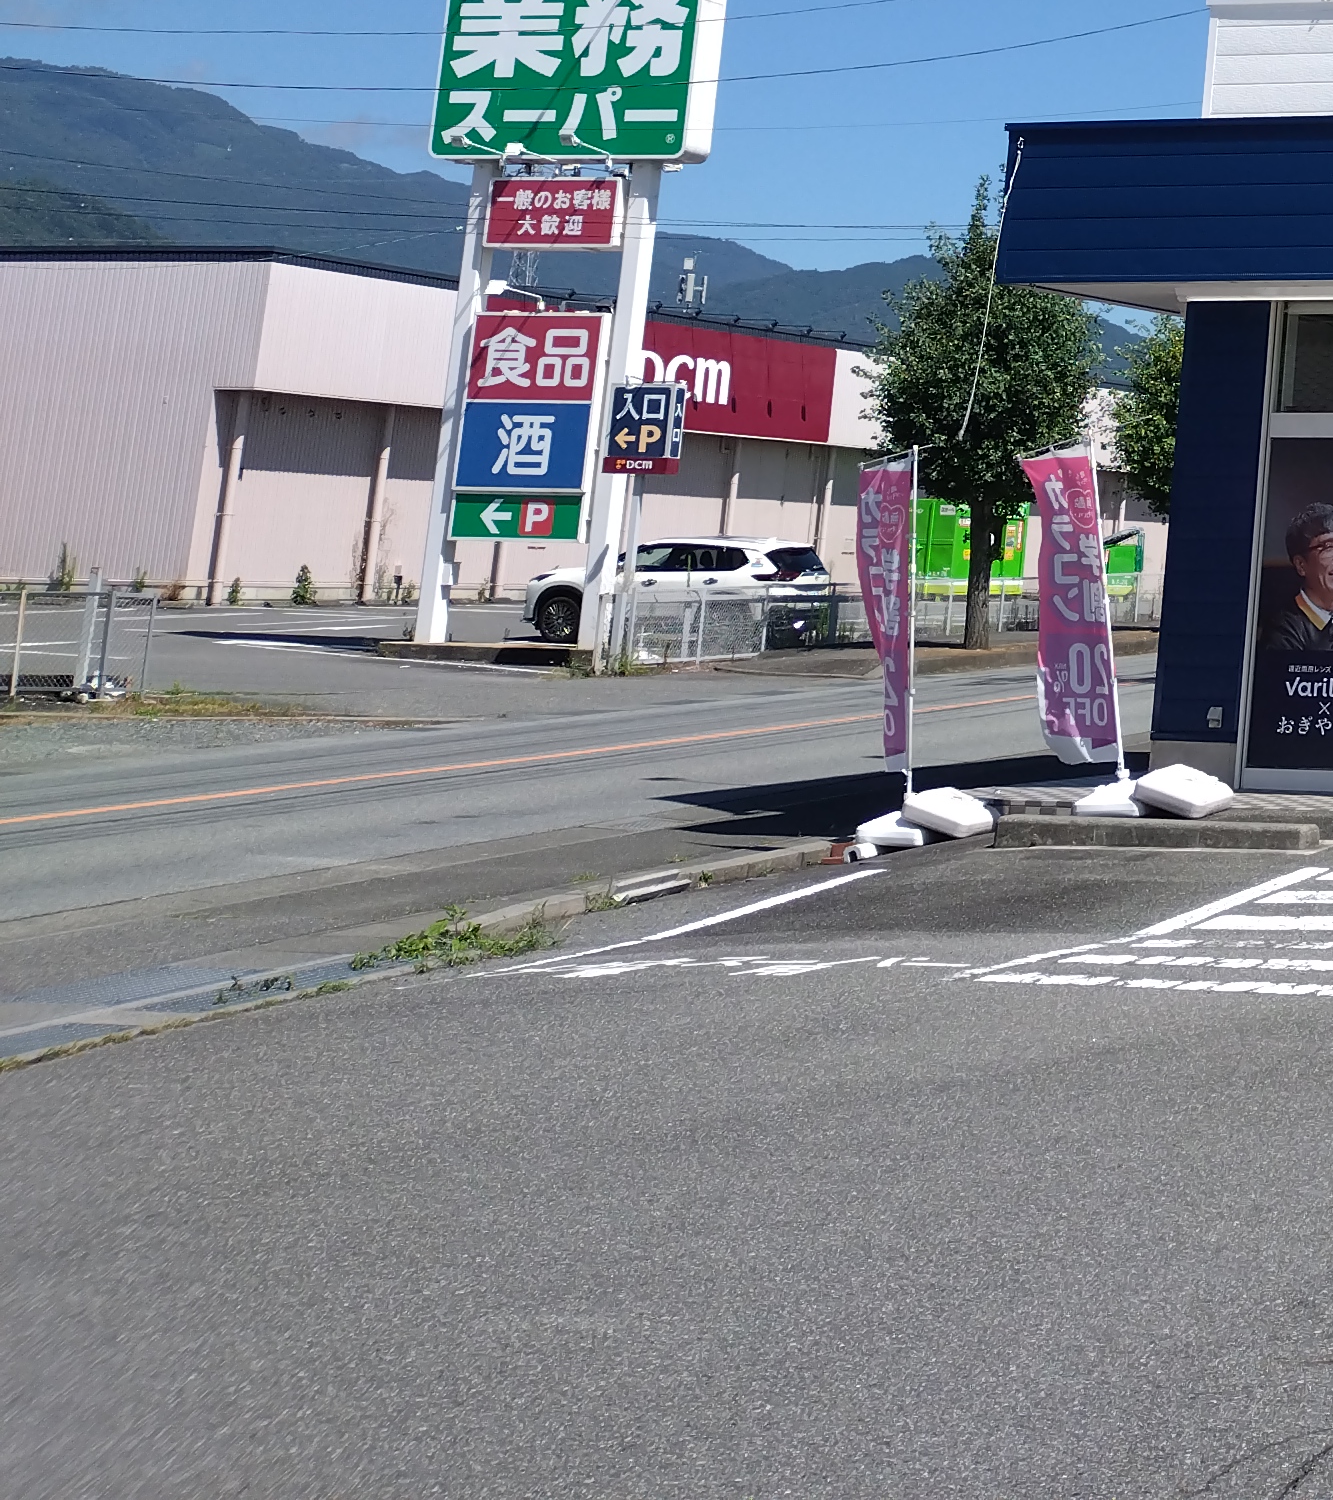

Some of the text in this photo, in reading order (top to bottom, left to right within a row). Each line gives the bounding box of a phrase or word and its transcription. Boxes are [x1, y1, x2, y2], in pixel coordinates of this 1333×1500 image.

[441, 85, 679, 144] スーパー
[496, 189, 612, 210] 一般のお客様
[517, 215, 583, 236] 大歓迎
[478, 327, 589, 388] 食品
[615, 393, 666, 420] 入口
[492, 414, 555, 477] 酒
[637, 425, 662, 453] P
[626, 460, 653, 470] DCM
[525, 503, 548, 532] P
